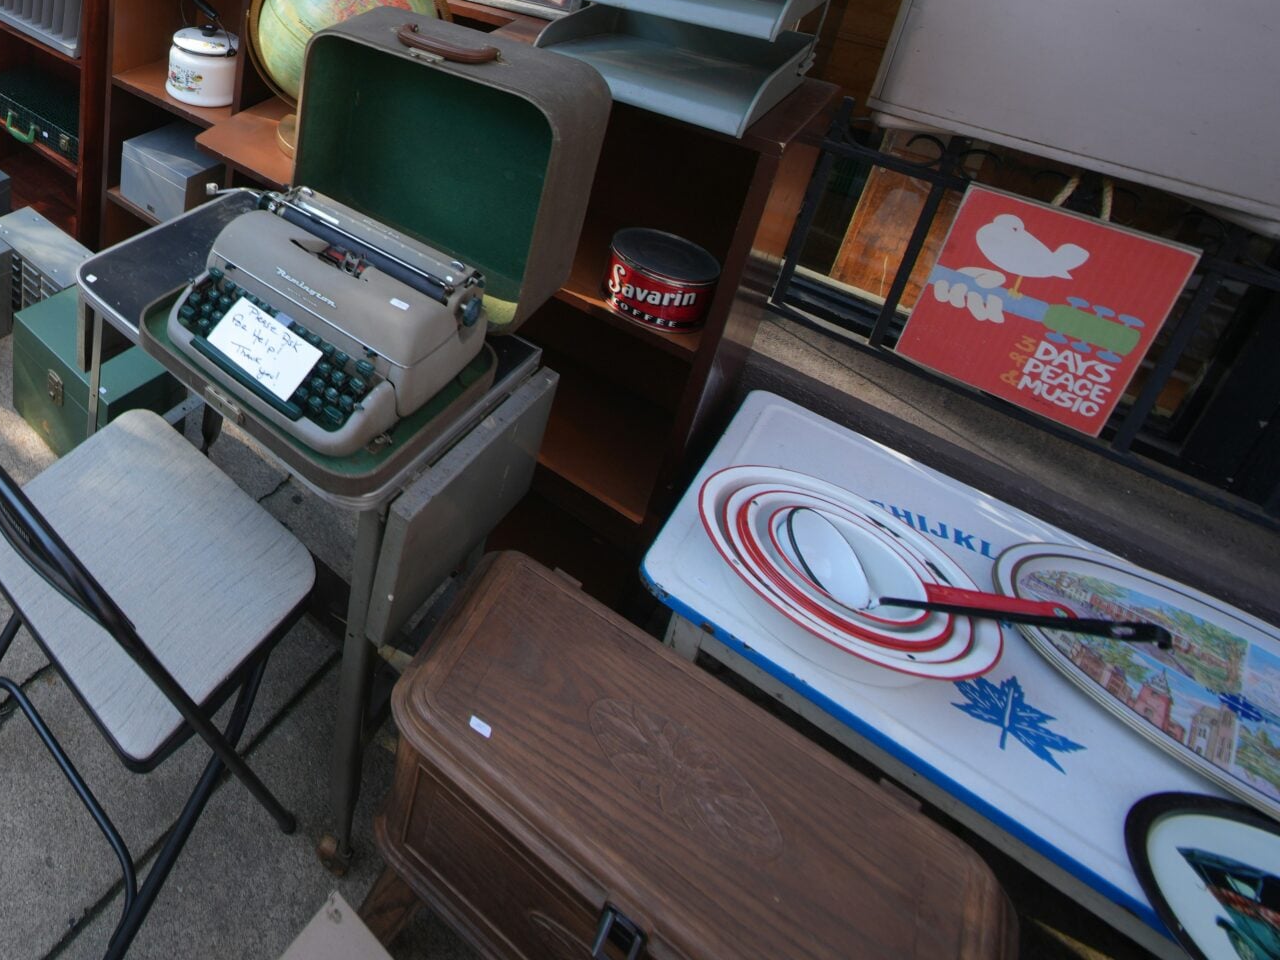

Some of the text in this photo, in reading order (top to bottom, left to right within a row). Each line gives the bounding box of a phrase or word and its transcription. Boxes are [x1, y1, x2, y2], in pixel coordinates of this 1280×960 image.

[275, 266, 337, 309] Remington
[608, 263, 697, 307] Savarin
[611, 296, 677, 328] COFFEE
[1014, 335, 1117, 383] 3 DAYS
[1022, 357, 1112, 405] PEACE
[999, 369, 1019, 387] &
[1016, 374, 1100, 417] MUSIC
